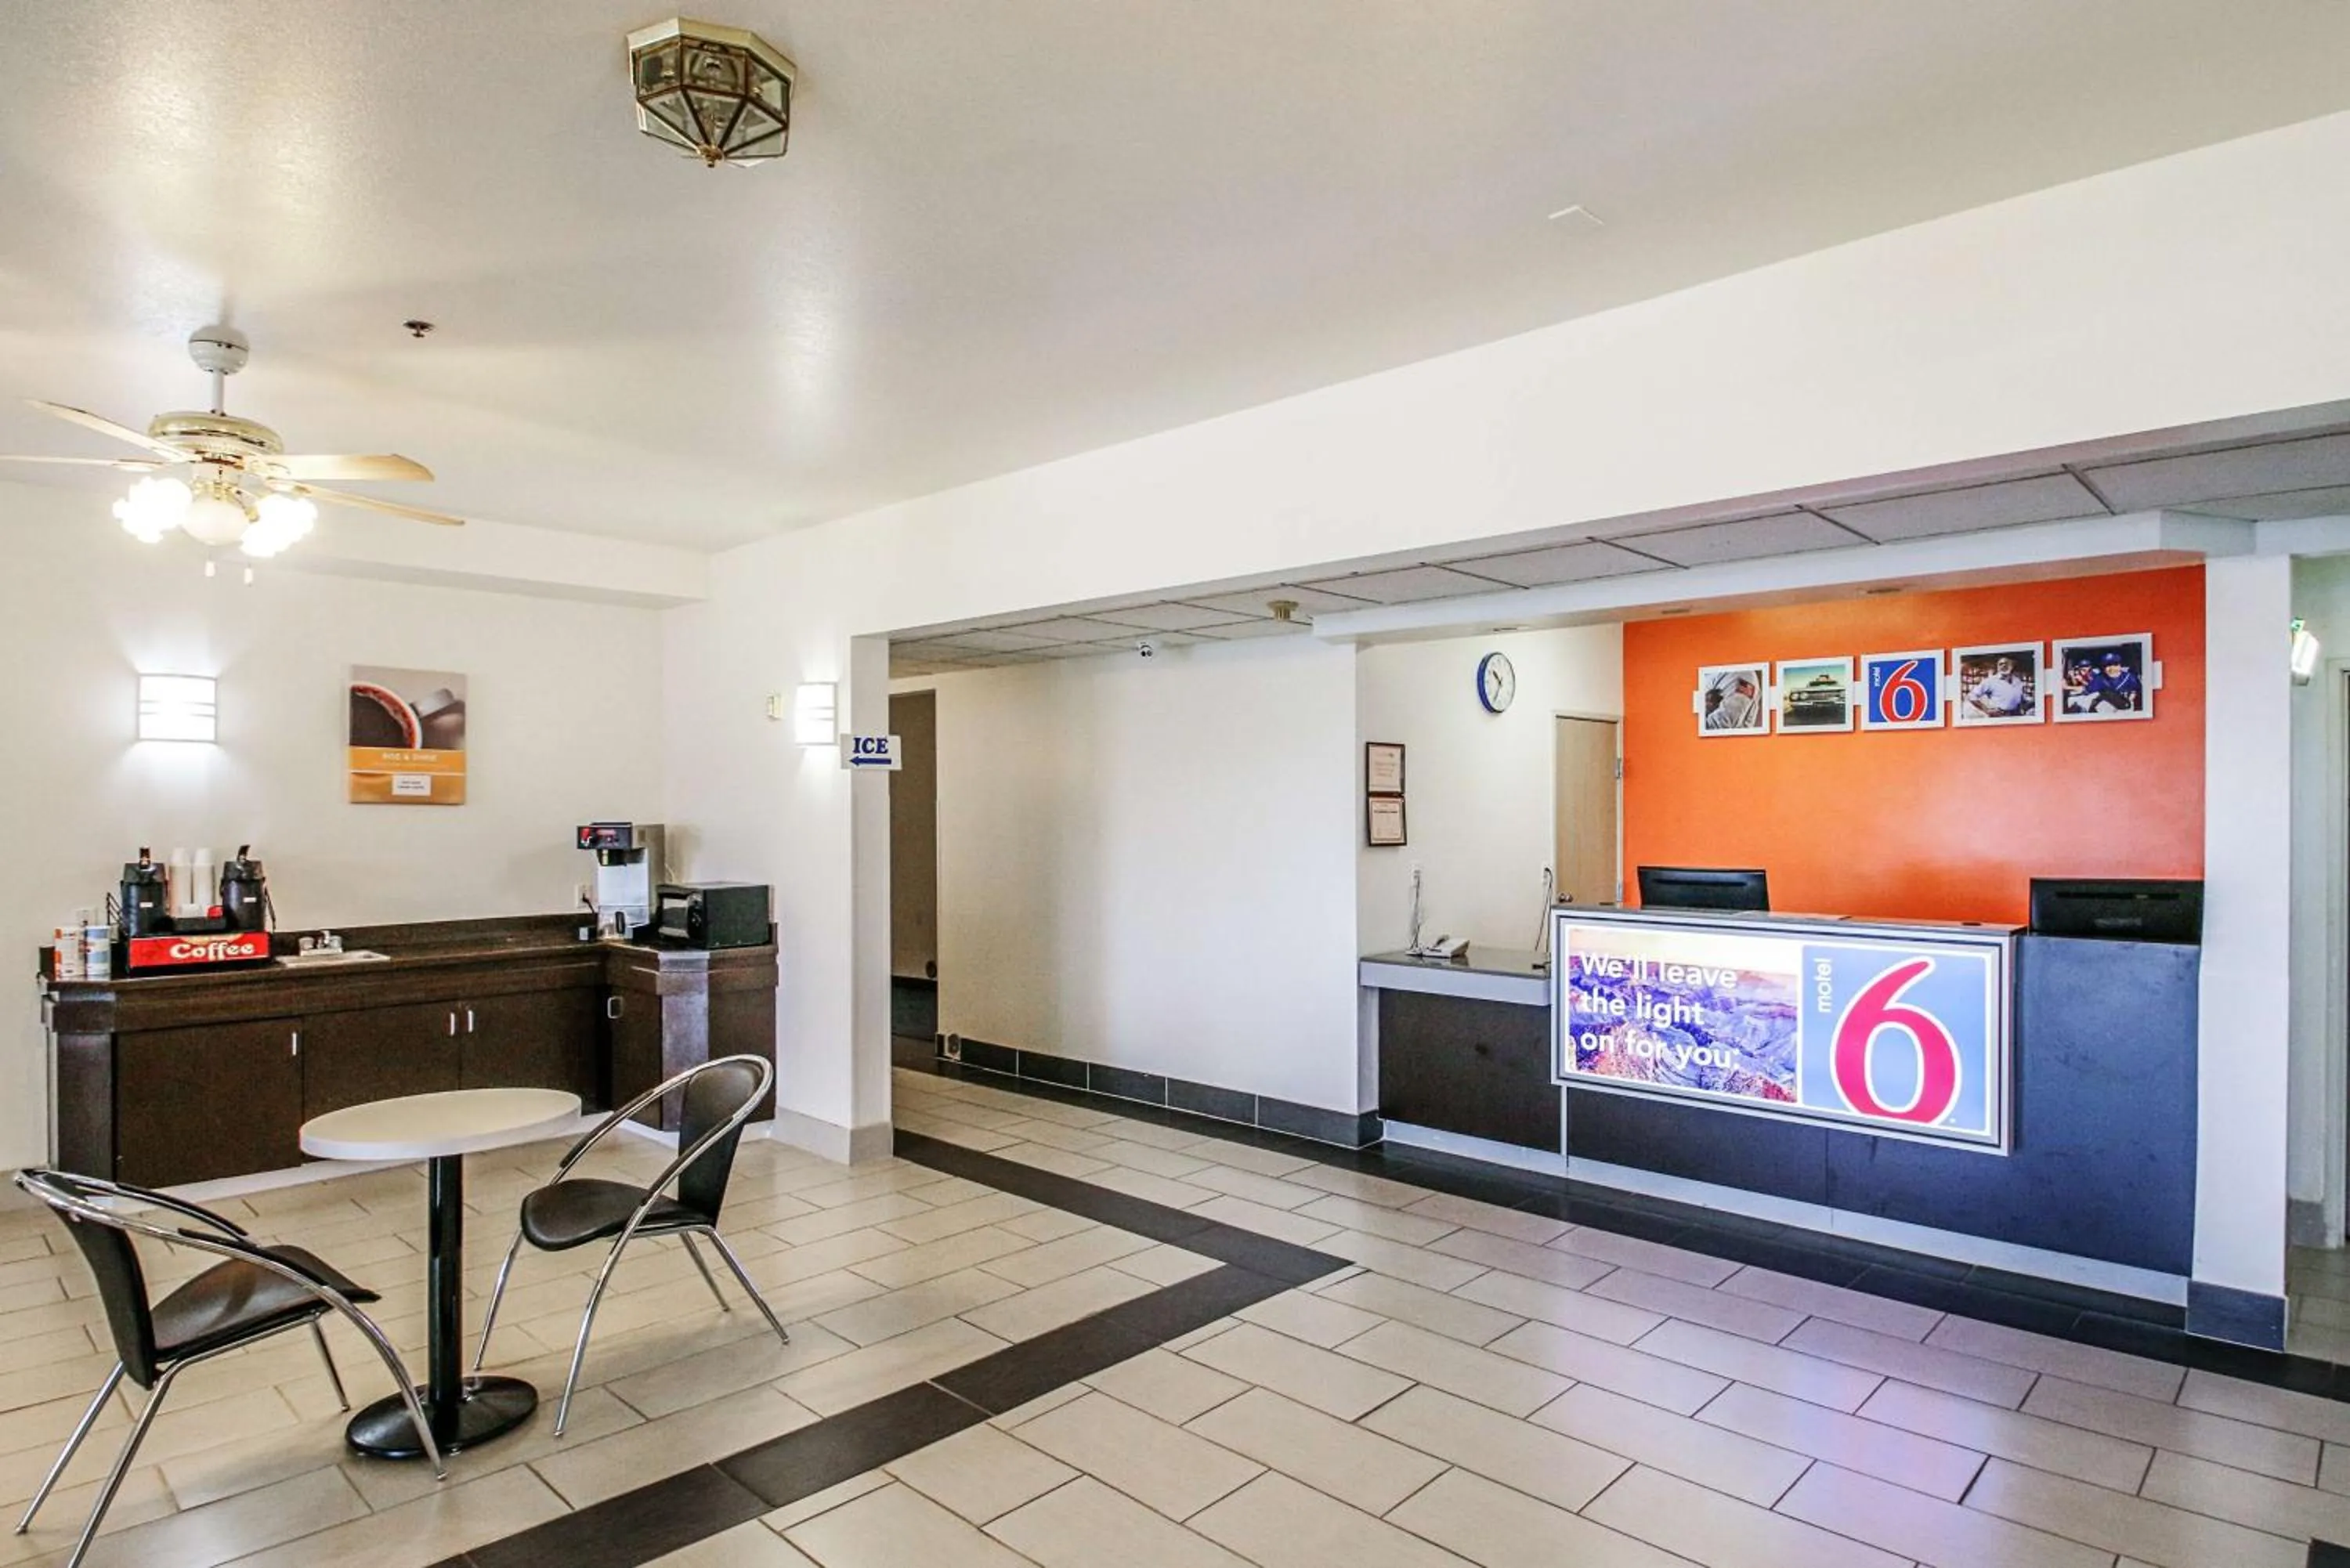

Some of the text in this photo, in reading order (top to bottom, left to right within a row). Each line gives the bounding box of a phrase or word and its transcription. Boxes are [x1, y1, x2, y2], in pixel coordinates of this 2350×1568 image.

[1880, 660, 1928, 723] 6
[853, 737, 889, 754] ICE
[169, 941, 255, 961] Coffee
[1580, 952, 1737, 988] We'll leave
[1583, 986, 1705, 1028] the light
[1580, 1031, 1614, 1055] on
[1625, 1029, 1668, 1059] for
[1813, 956, 1962, 1125] motel 6
